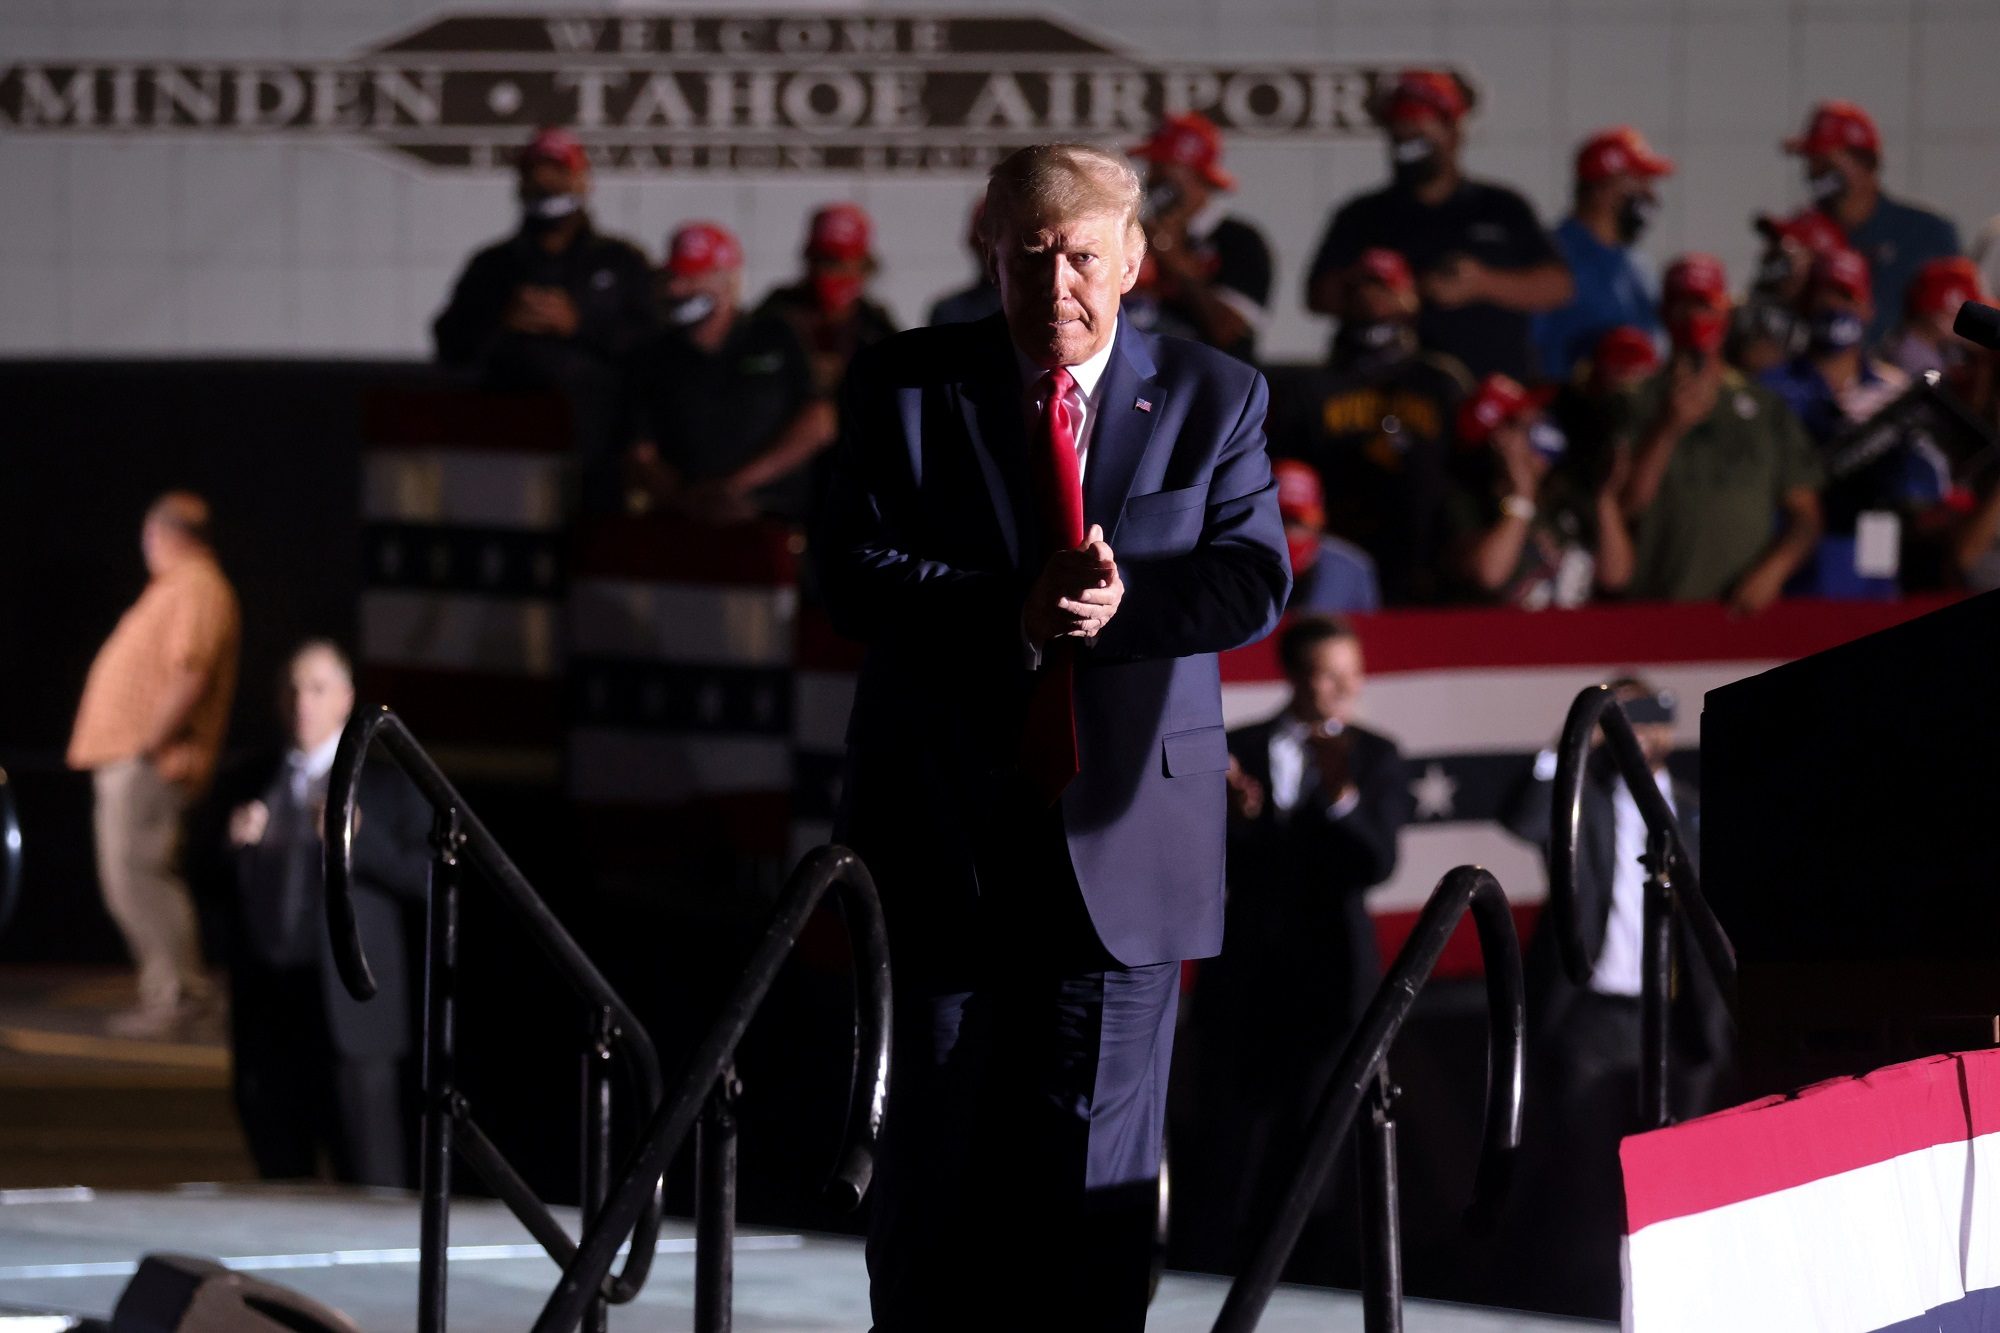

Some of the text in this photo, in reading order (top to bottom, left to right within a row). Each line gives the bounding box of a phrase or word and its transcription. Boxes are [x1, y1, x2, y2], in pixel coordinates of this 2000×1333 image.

[546, 17, 950, 58] WELCOME
[20, 65, 1398, 132] MINDEN TAHOE AIRPOR
